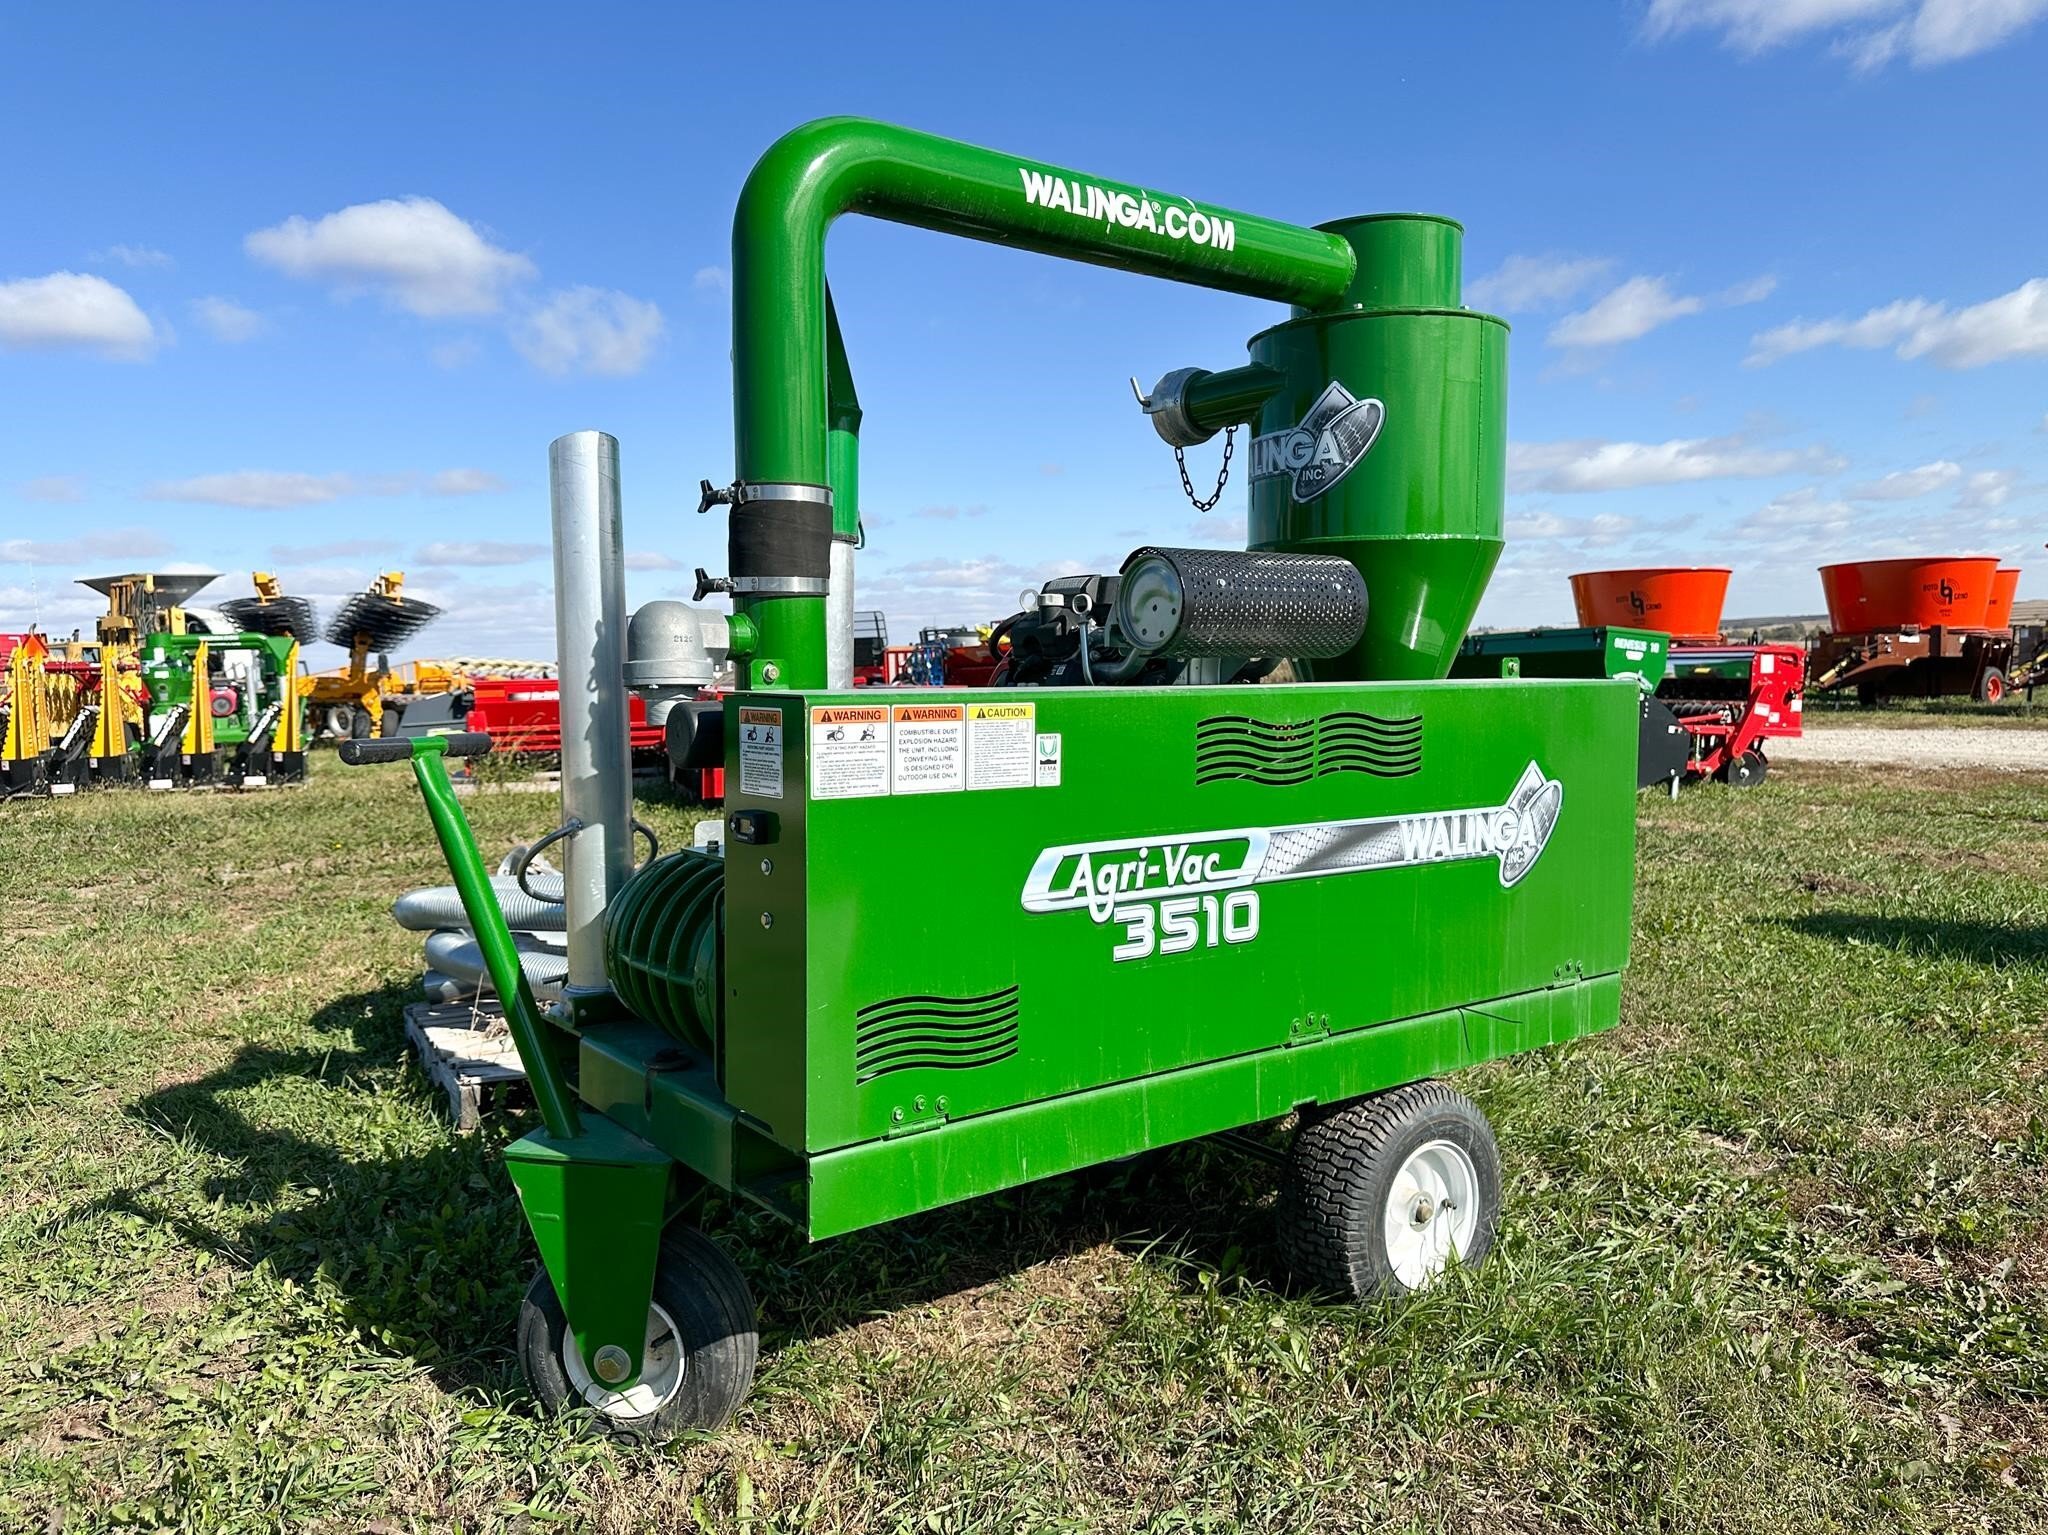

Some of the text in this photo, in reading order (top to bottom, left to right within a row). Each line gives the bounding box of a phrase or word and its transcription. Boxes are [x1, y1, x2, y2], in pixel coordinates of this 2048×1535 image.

[1302, 469, 1325, 481] INC.
[750, 711, 778, 723] WARNING
[833, 710, 881, 721] WARNING
[913, 708, 957, 719] WARNING
[987, 707, 1026, 717] CAUTION
[903, 755, 938, 763] CONVEYING
[910, 764, 940, 772] DESIGNED
[898, 773, 928, 781] OUTDOOR
[1401, 808, 1537, 861] WALINGA
[1069, 844, 1220, 924] Agri-Vac
[1113, 890, 1260, 962] 3510
